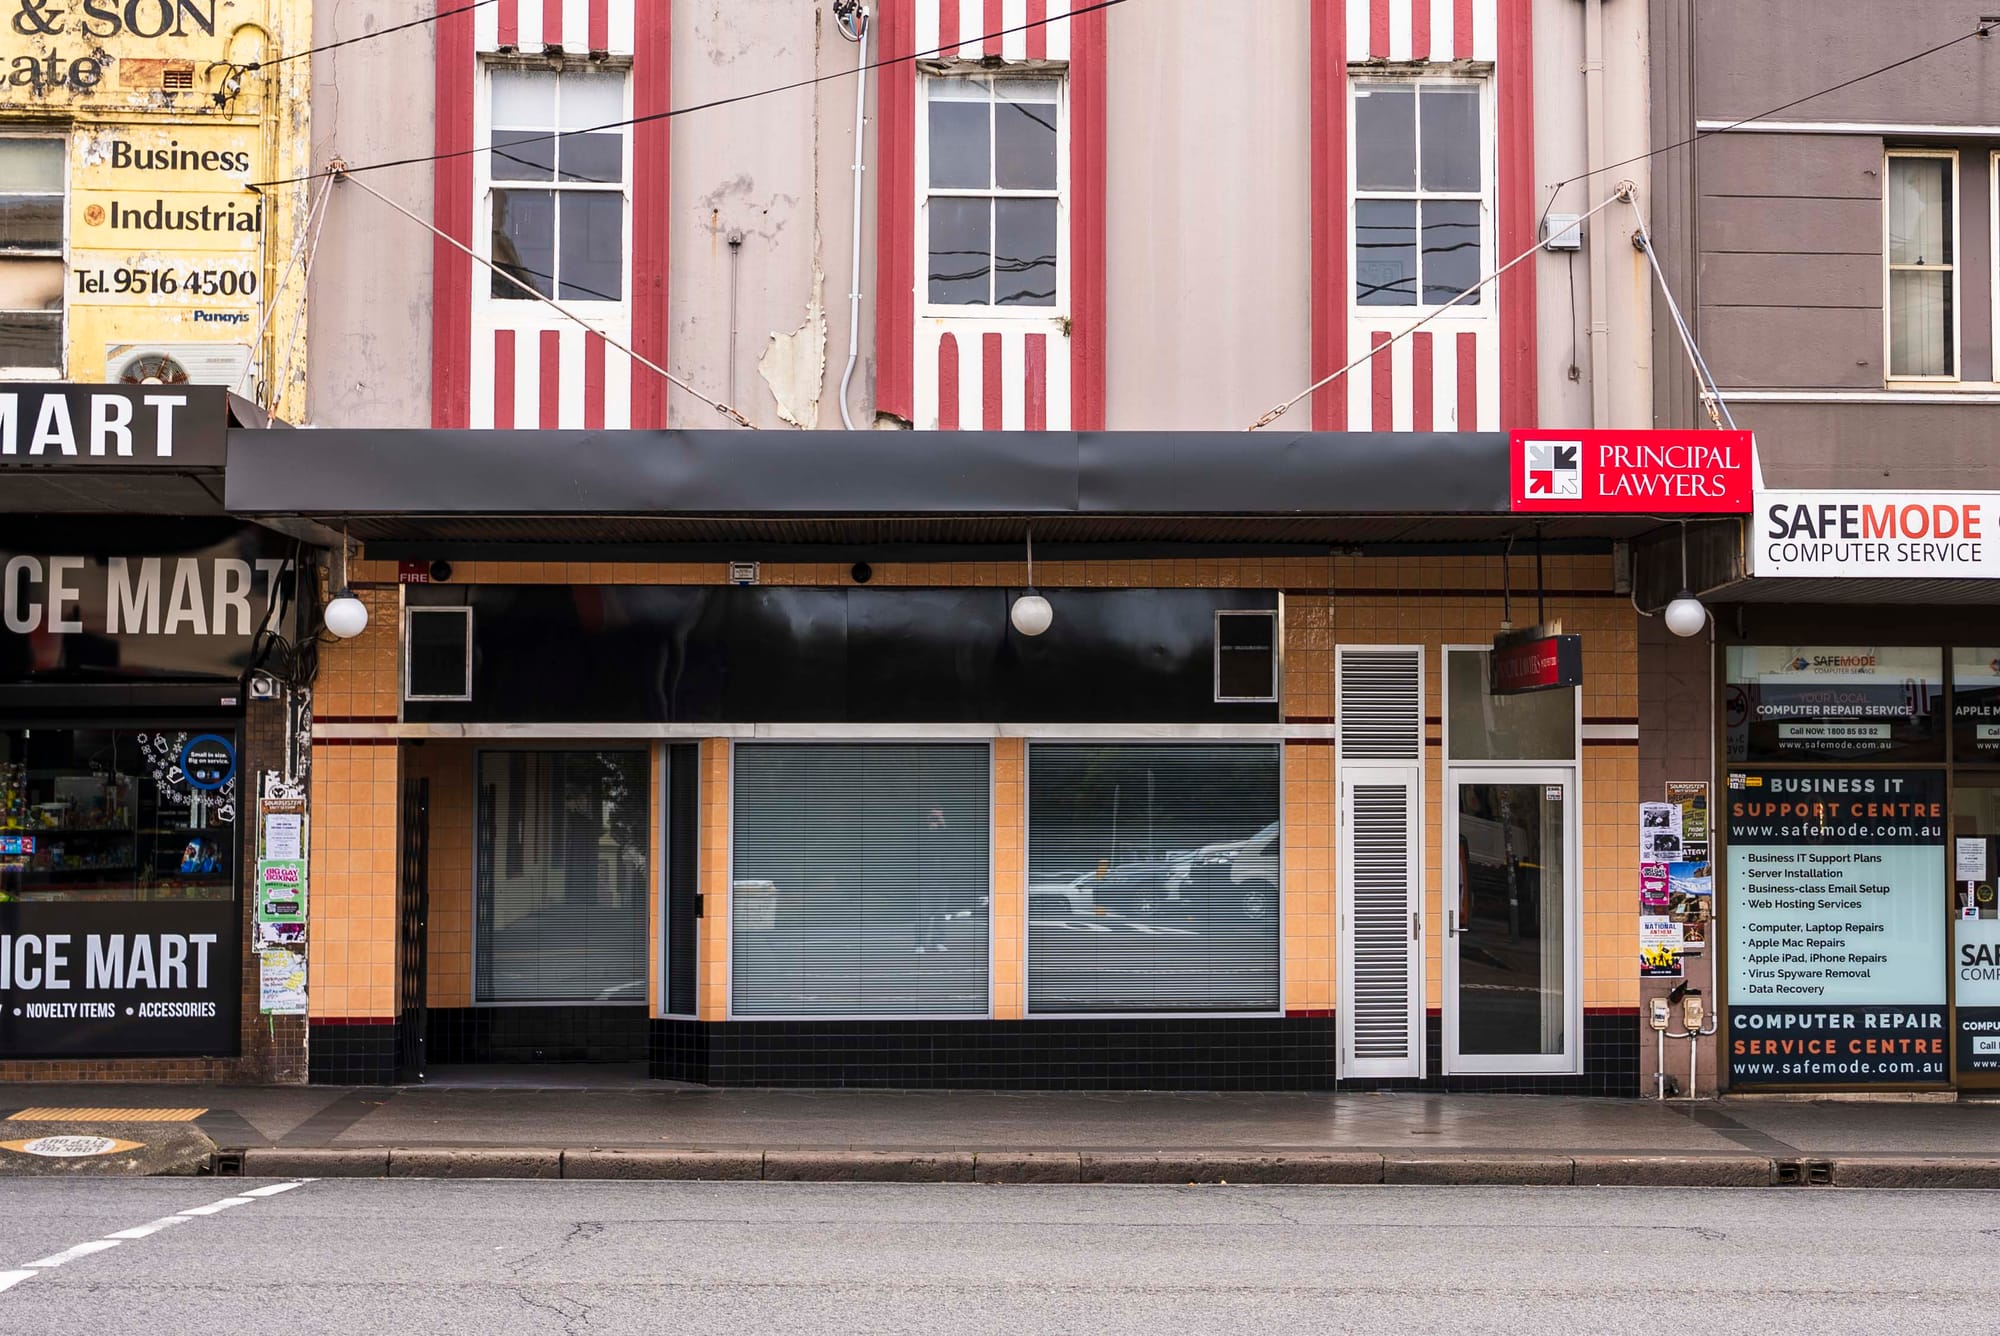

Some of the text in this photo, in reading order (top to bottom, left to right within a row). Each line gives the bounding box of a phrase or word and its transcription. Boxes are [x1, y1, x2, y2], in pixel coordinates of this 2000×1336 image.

[12, 0, 216, 38] & SON
[0, 47, 103, 88] ate
[111, 141, 250, 172] Business
[111, 200, 262, 232] Industrial
[74, 269, 257, 295] Tel. 9516 4500
[193, 311, 250, 324] Panayis
[1599, 445, 1741, 469] PRINCIPAL
[1599, 473, 1726, 497] LAWYERS
[1768, 504, 1982, 539] SAFEMODE
[1768, 543, 1982, 562] COMPUTER SERVICE
[400, 573, 428, 583] FIRE
[106, 556, 294, 635] MART
[1813, 656, 1876, 666] SAFEMODE
[1757, 705, 1913, 715] COMPUTER REPAIR SERVICE
[1955, 706, 1991, 716] APPLE
[1790, 727, 1878, 735] Call NOW: 1800 85 83 82
[1779, 741, 1891, 749] www.safemode.com.au
[1771, 779, 1875, 792] BUSINESS
[1885, 779, 1903, 792] IT
[1733, 803, 1941, 817] SUPPORT CENTRE
[1732, 823, 1941, 836] www.safemode.com.au
[1749, 854, 1882, 865] Business IT Support Plans
[266, 874, 298, 882] BOXING
[1749, 869, 1842, 878] Server Installation
[1749, 885, 1890, 896] Business-class Email Setup
[1749, 900, 1862, 911] Web Hosting Services
[1749, 923, 1884, 934] Computer, Laptop Repairs
[1749, 938, 1845, 949] Apple Mac Repairs
[86, 934, 217, 989] MART
[1749, 954, 1887, 965] Apple iPad, iPhone Repairs
[1749, 969, 1870, 980] Virus Spyware Removal
[1749, 985, 1824, 995] Data Recovery
[26, 1002, 216, 1018] NOVELTY ITEMS ACCESSORIES
[1734, 1013, 1942, 1029] COMPUTER REPAIR
[1734, 1039, 1942, 1055] SERVICE CENTRE
[1980, 1042, 1996, 1050] Call
[1734, 1060, 1943, 1074] www.safemode.com.au
